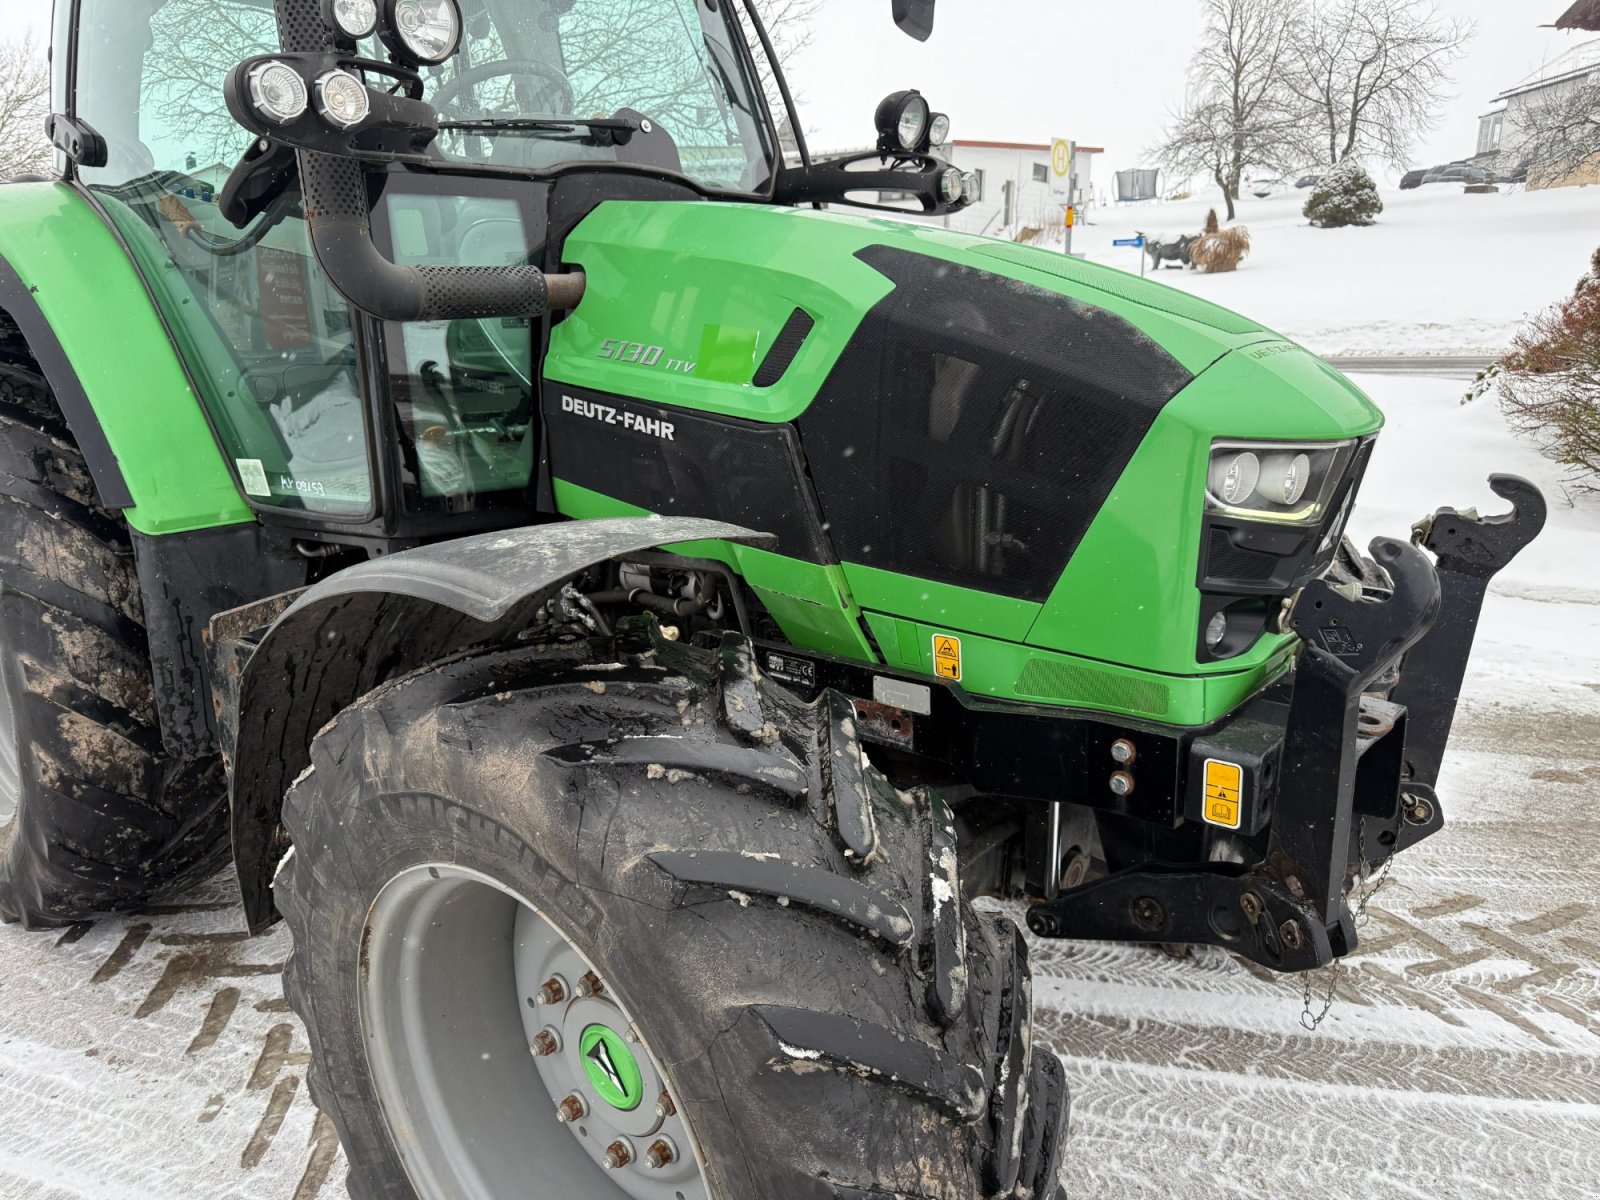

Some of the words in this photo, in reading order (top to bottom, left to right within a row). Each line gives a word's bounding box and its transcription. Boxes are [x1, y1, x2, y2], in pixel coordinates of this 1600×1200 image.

[597, 338, 664, 367] 5130
[665, 358, 696, 373] TTV
[561, 395, 675, 441] DEUTZ-FAHR
